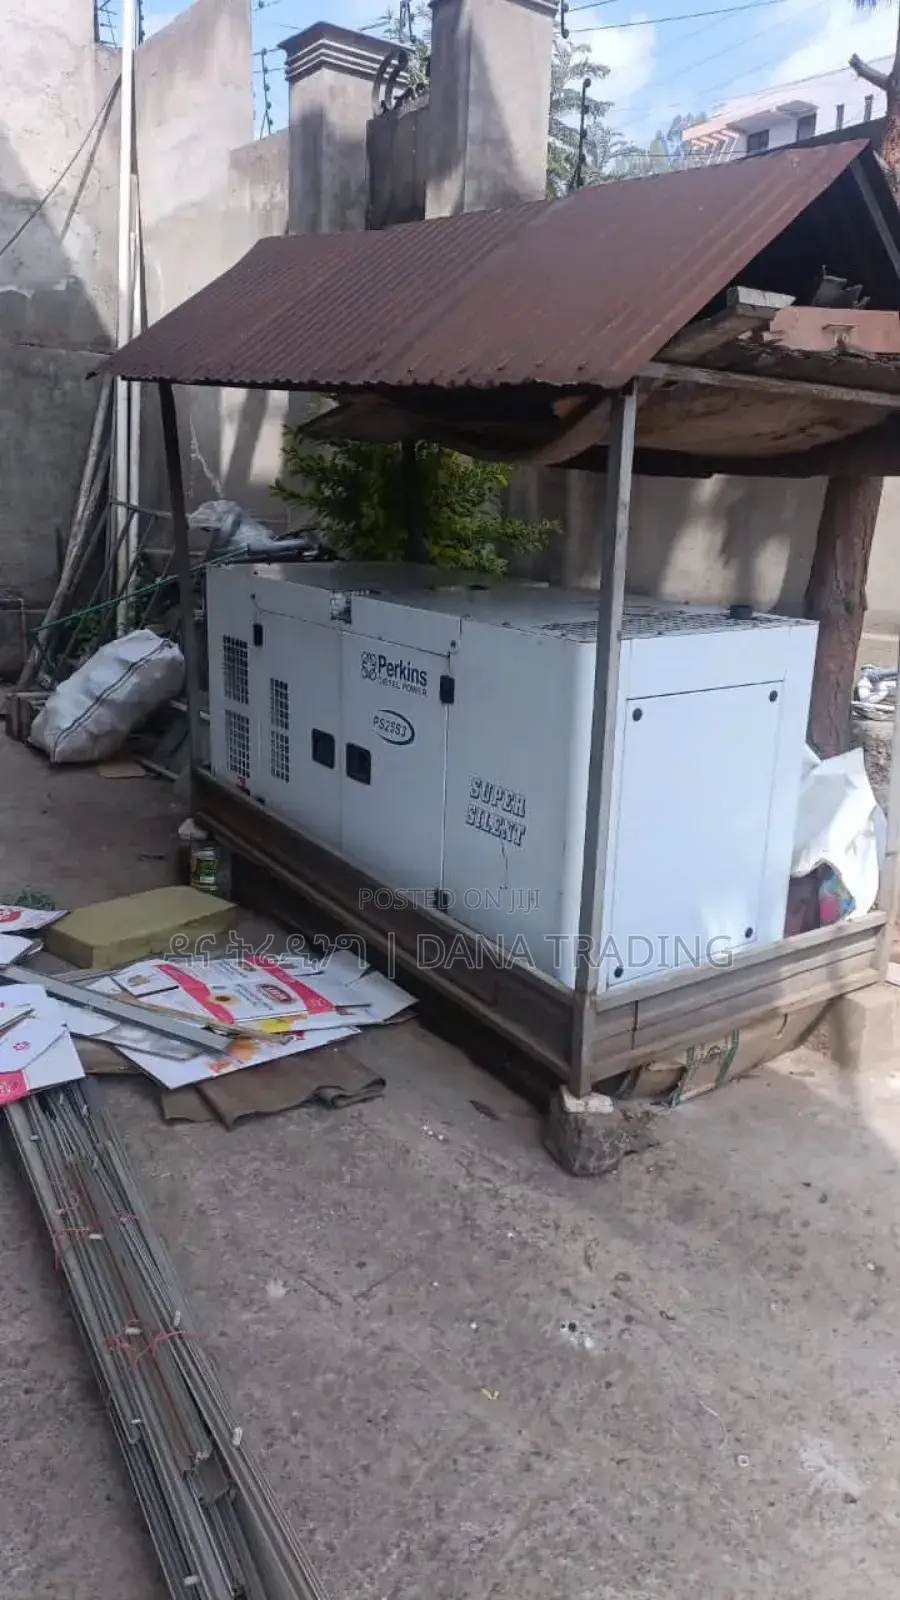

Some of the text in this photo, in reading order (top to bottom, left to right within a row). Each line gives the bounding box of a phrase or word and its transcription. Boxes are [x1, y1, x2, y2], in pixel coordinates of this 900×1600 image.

[378, 654, 428, 687] Perkins
[468, 777, 526, 818] SUPER
[465, 804, 526, 846] SILENT
